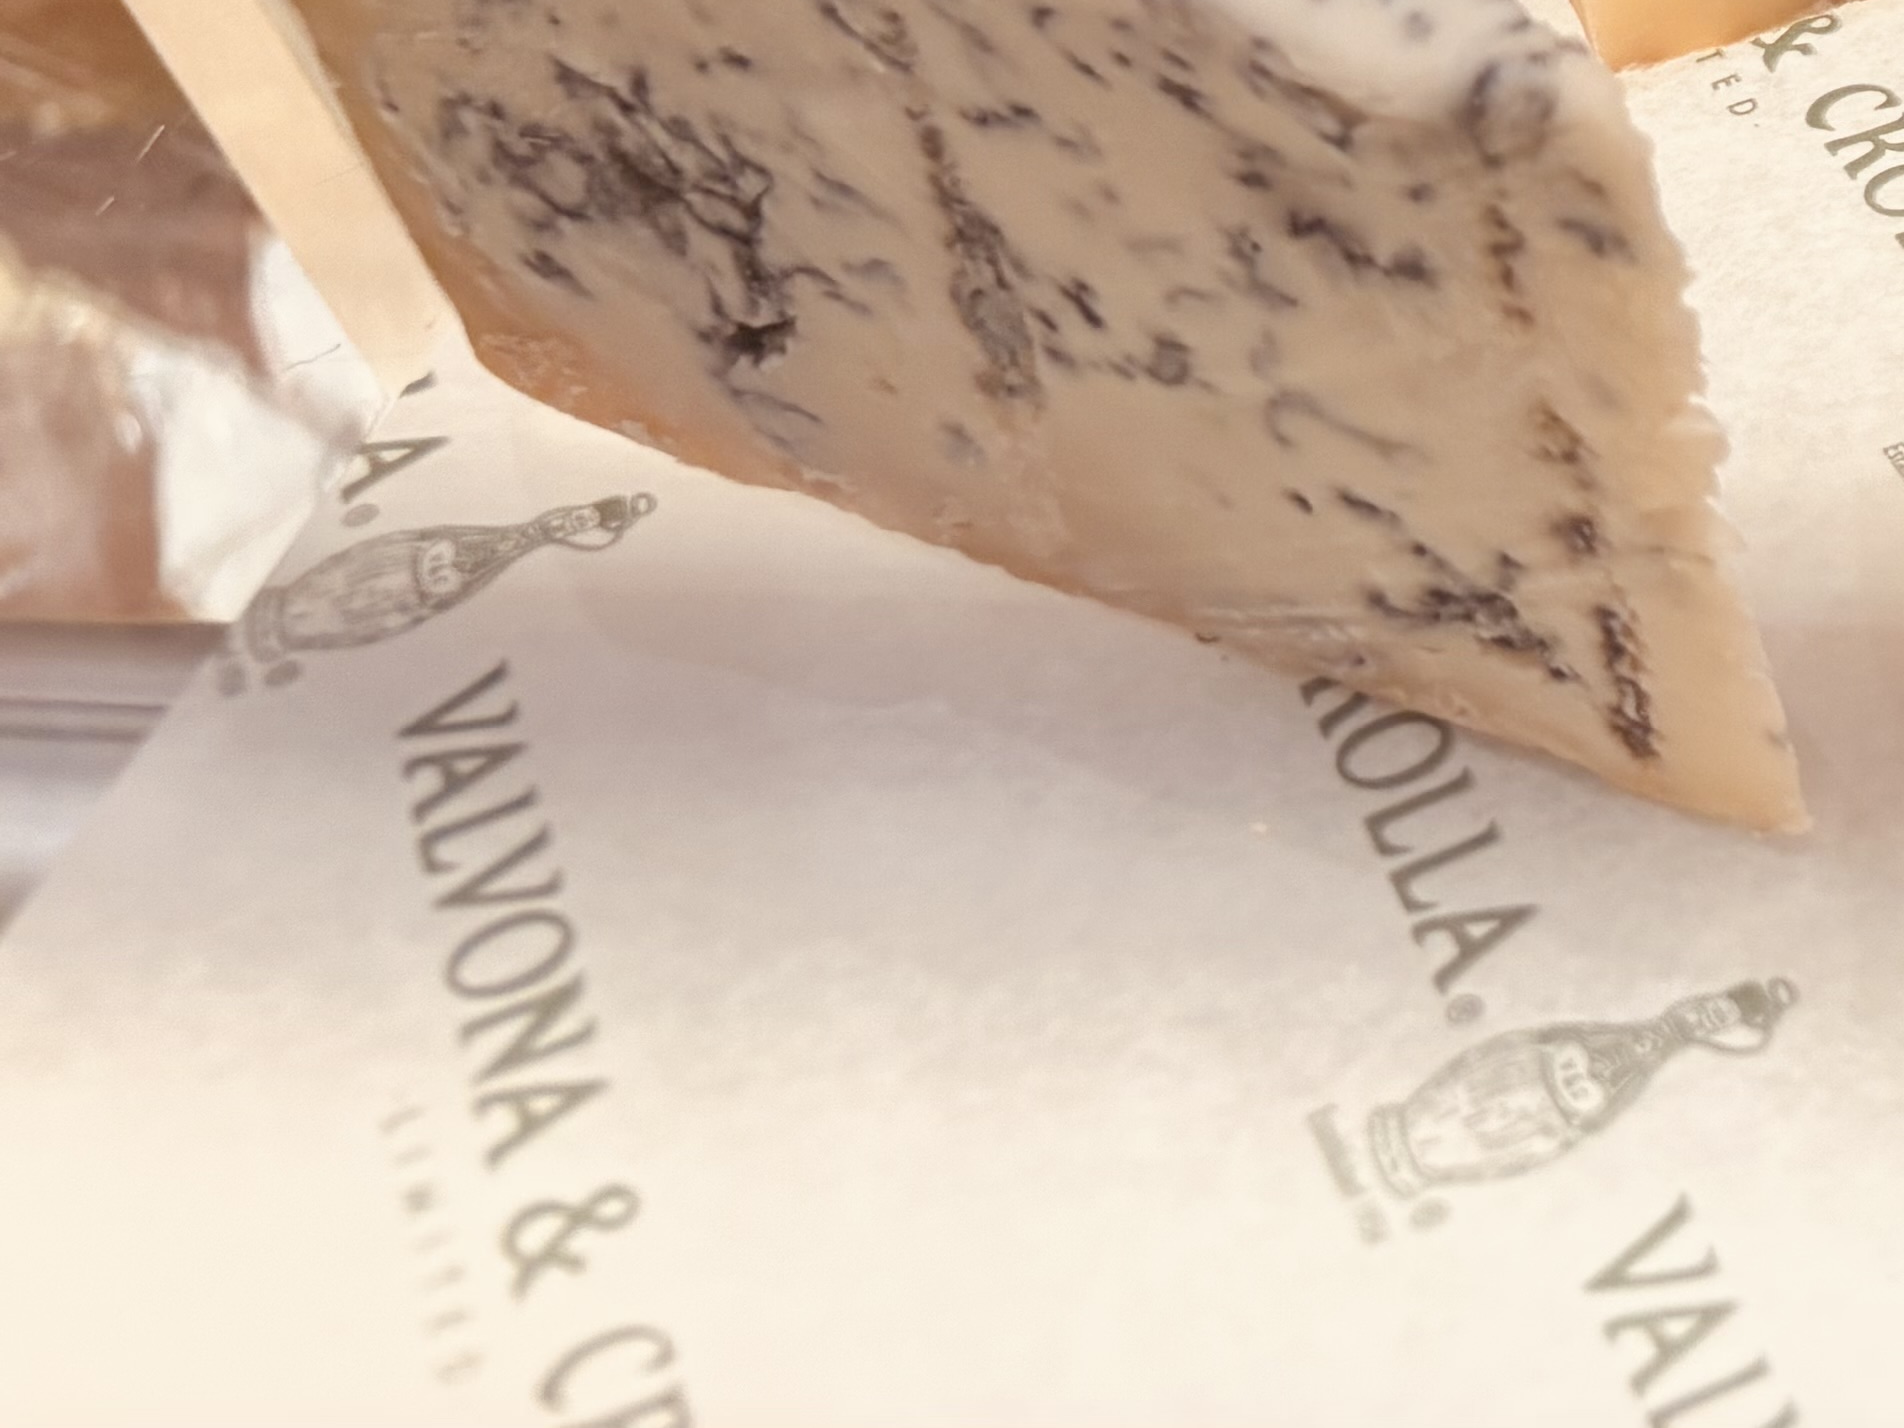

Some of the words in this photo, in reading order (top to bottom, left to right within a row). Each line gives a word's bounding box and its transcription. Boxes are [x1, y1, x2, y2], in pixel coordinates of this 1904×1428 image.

[395, 660, 613, 1170] VALVONA
[500, 1180, 642, 1300] &
[1580, 1190, 1803, 1428] VAL
